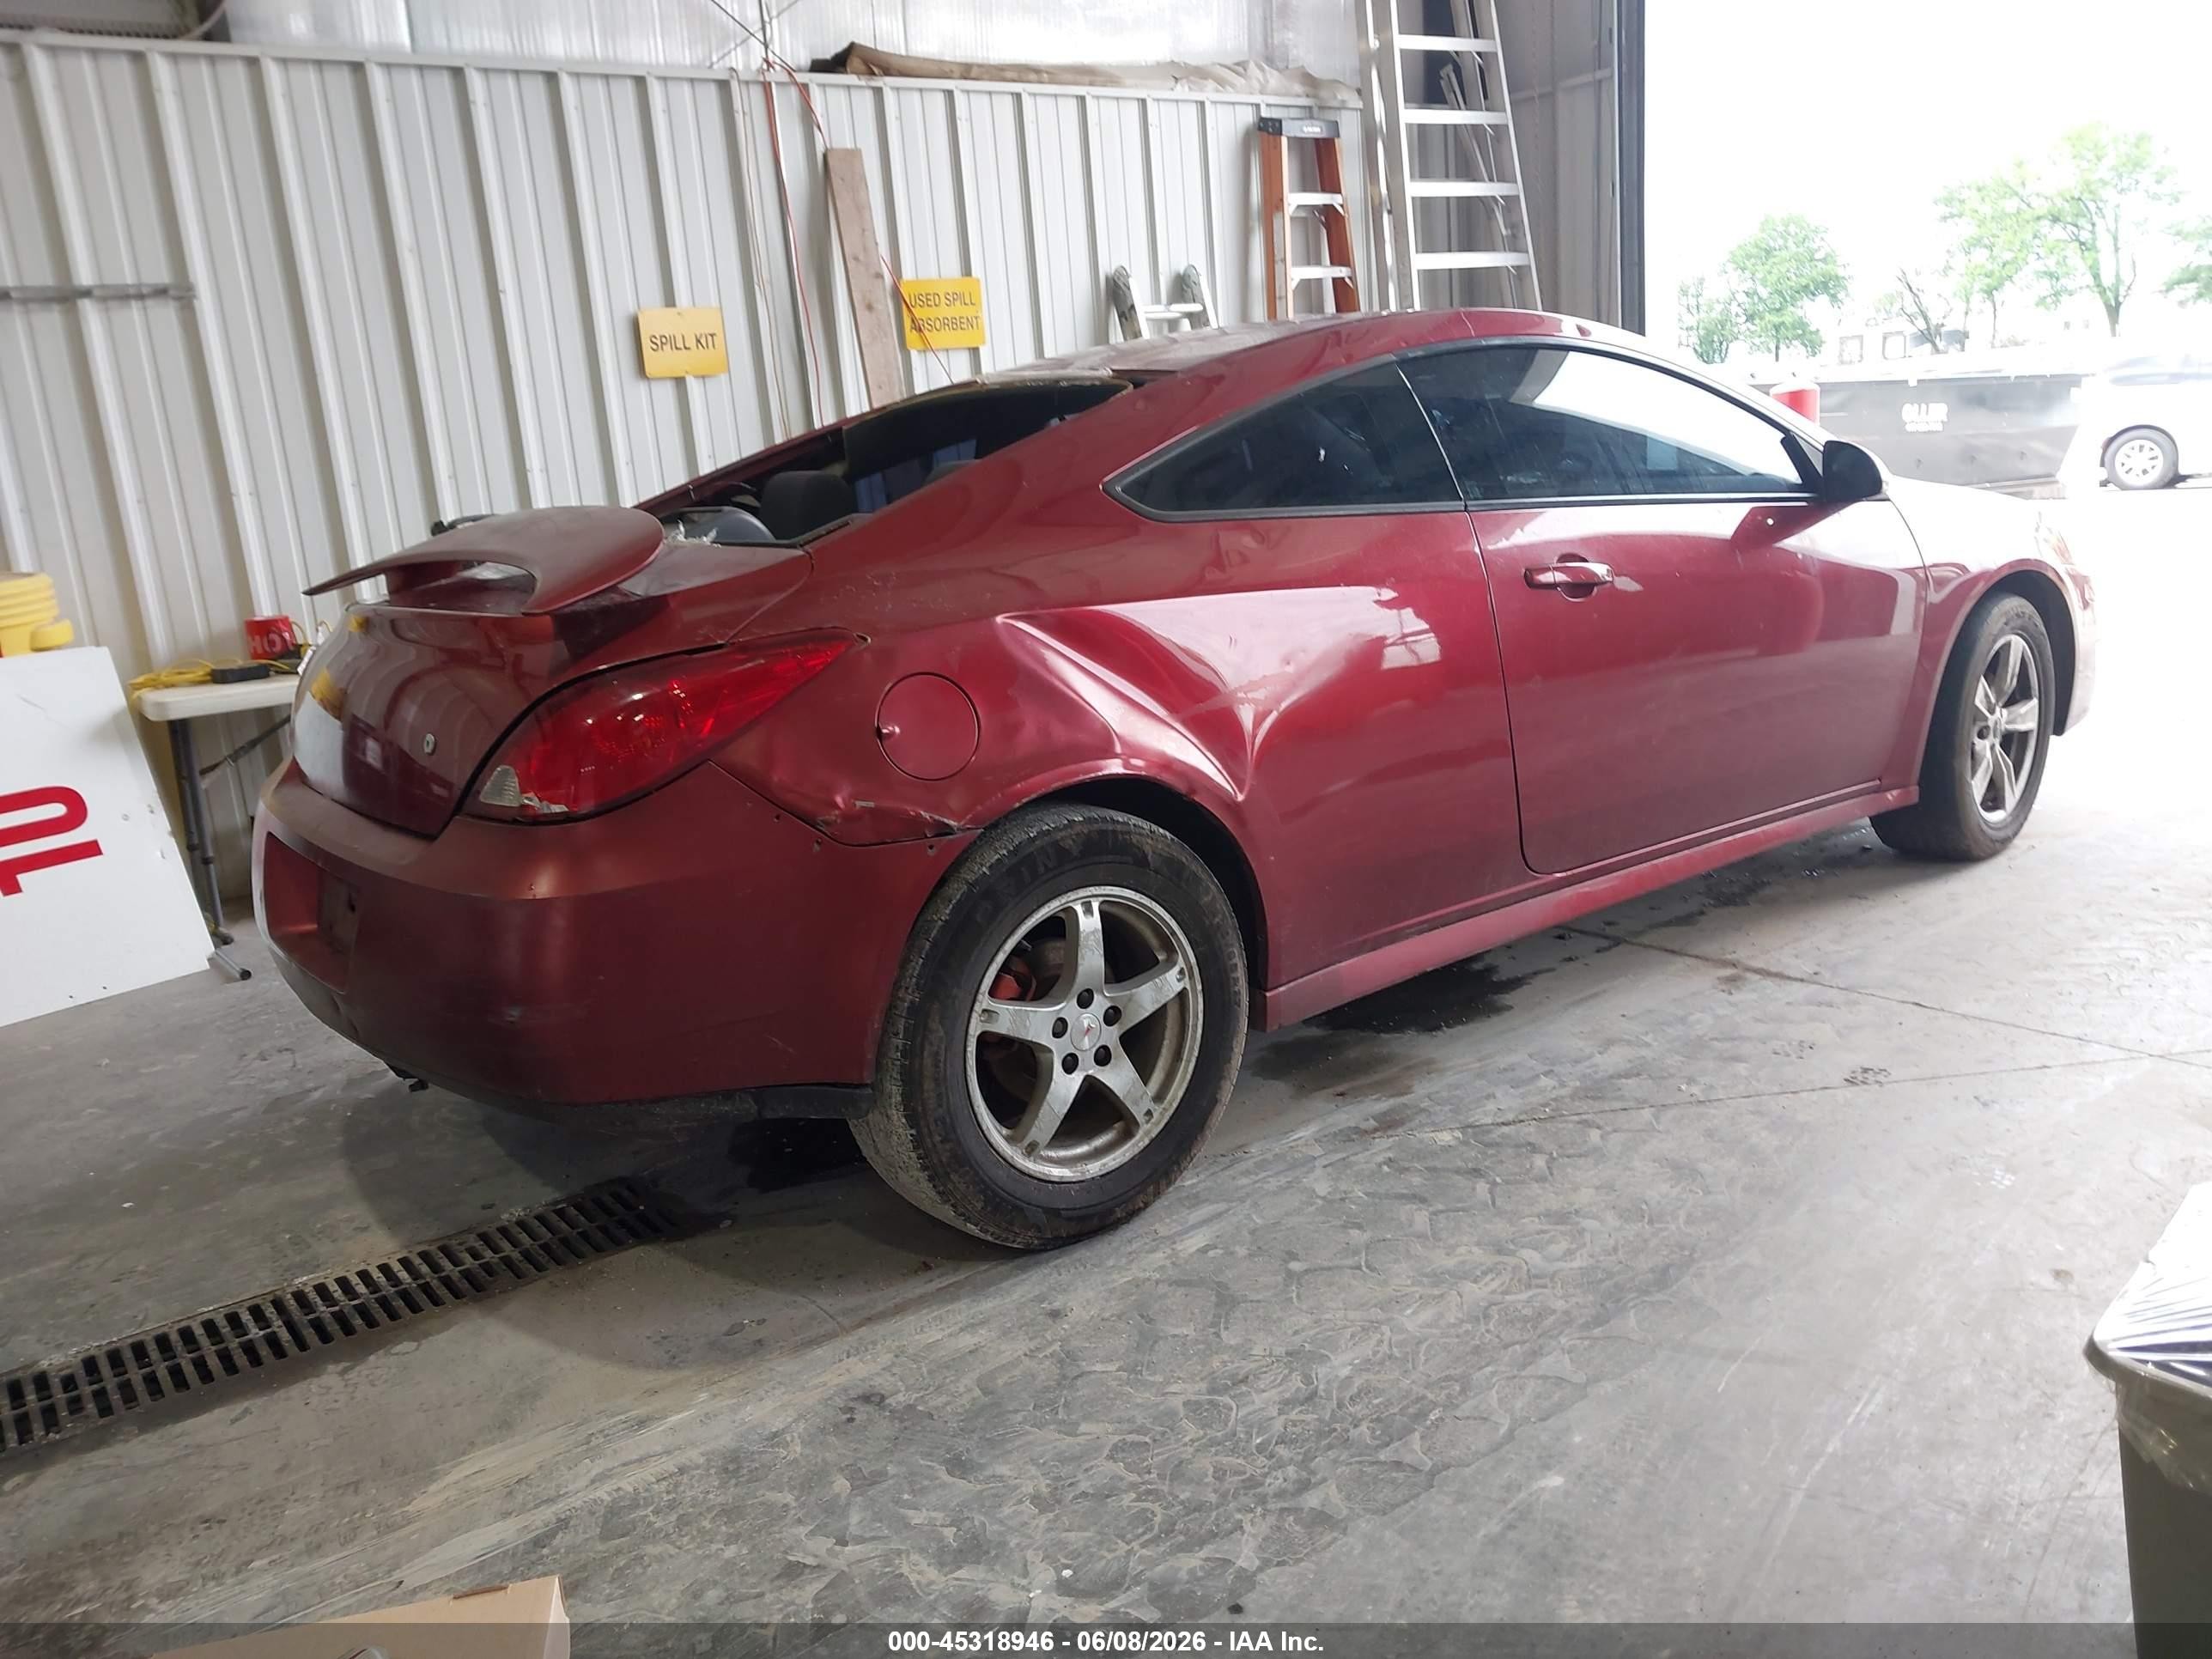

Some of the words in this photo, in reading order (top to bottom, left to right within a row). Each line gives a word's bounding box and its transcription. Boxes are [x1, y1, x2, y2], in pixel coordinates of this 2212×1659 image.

[908, 292, 941, 308] USED
[944, 291, 976, 307] SPILL
[909, 315, 980, 333] ABSORBENT
[649, 333, 691, 353] SPILL
[694, 331, 718, 351] KIT
